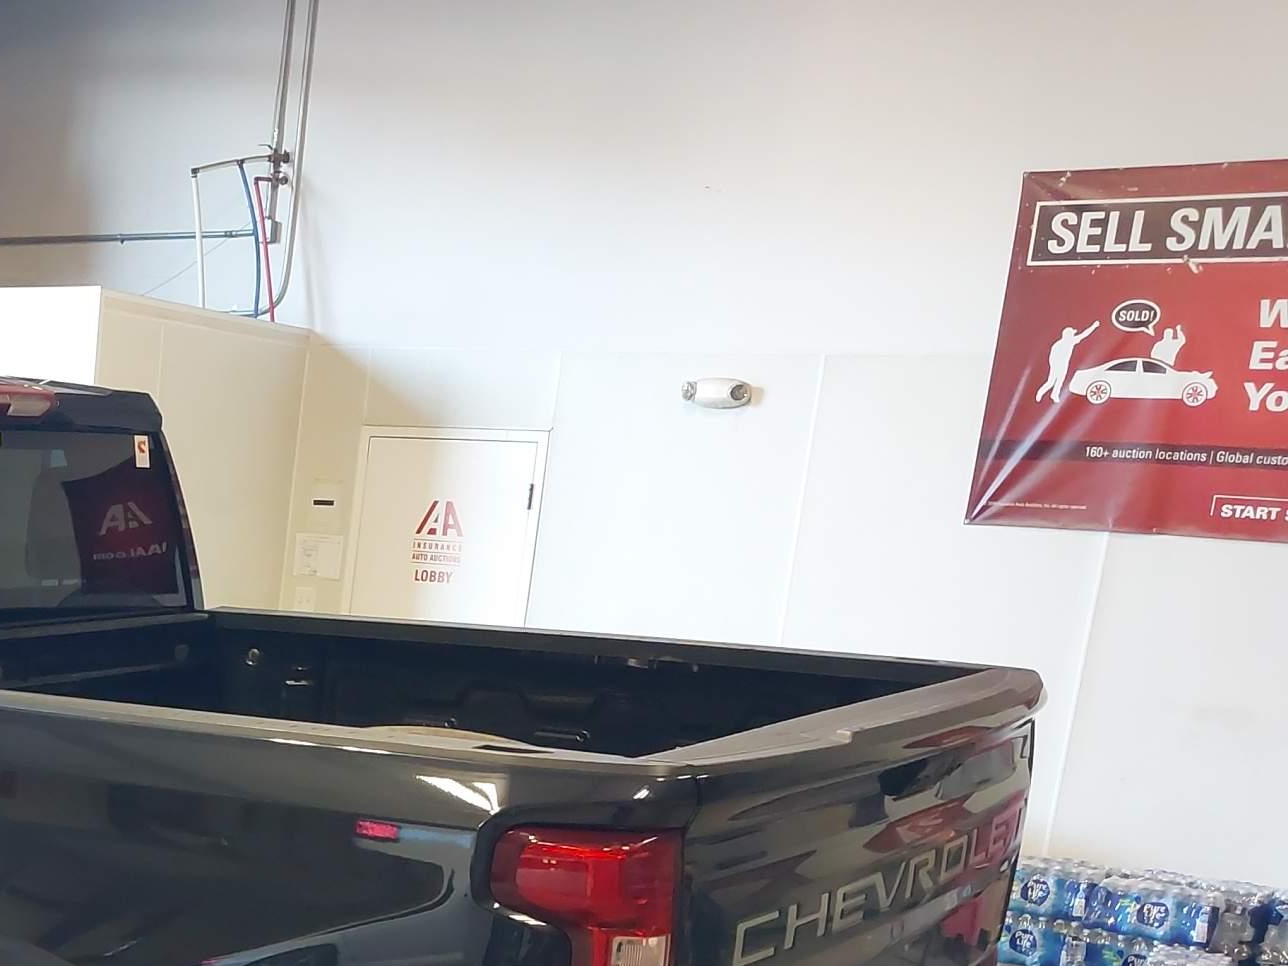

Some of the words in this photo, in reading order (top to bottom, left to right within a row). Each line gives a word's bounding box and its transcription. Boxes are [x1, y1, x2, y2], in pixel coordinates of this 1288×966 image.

[1047, 209, 1153, 255] SELL
[1166, 205, 1288, 252] SMA
[1118, 310, 1155, 323] SOLD!
[1248, 340, 1288, 370] Ea
[1243, 381, 1288, 413] Yo
[1085, 446, 1109, 458] 160+
[1112, 447, 1152, 460] auction
[1155, 448, 1207, 462] locations
[1216, 450, 1254, 464] Global
[1220, 503, 1281, 521] START
[412, 541, 462, 553] INSURANCE
[412, 552, 428, 561] AUTO
[414, 569, 453, 584] LOBBY
[1015, 930, 1034, 942] Pure
